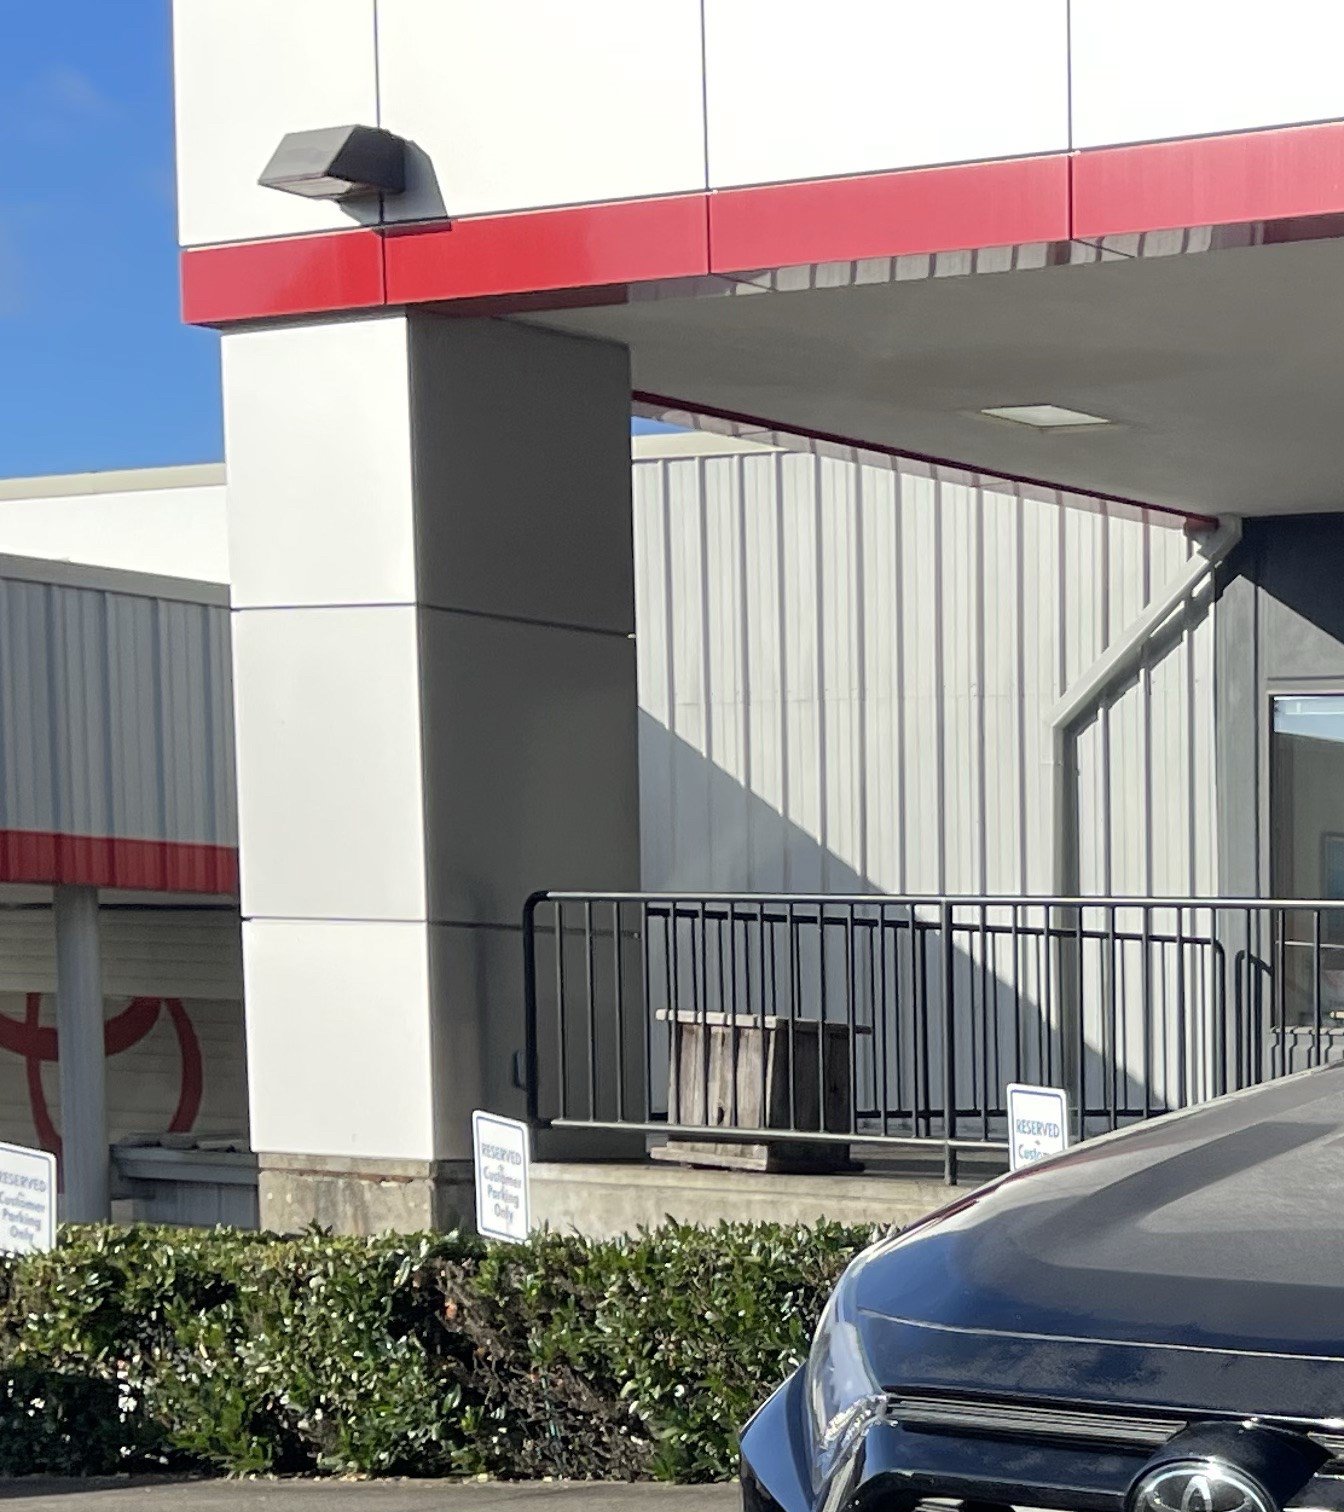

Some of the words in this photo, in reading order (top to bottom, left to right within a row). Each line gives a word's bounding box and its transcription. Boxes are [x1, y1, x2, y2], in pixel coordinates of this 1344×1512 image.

[1016, 1119, 1060, 1138] RESERVED
[481, 1143, 522, 1166] RESERVED
[483, 1165, 522, 1189] Customer
[487, 1183, 519, 1210] Parking
[2, 1207, 41, 1232] Parking
[494, 1203, 514, 1224] Only
[10, 1225, 34, 1243] Only
